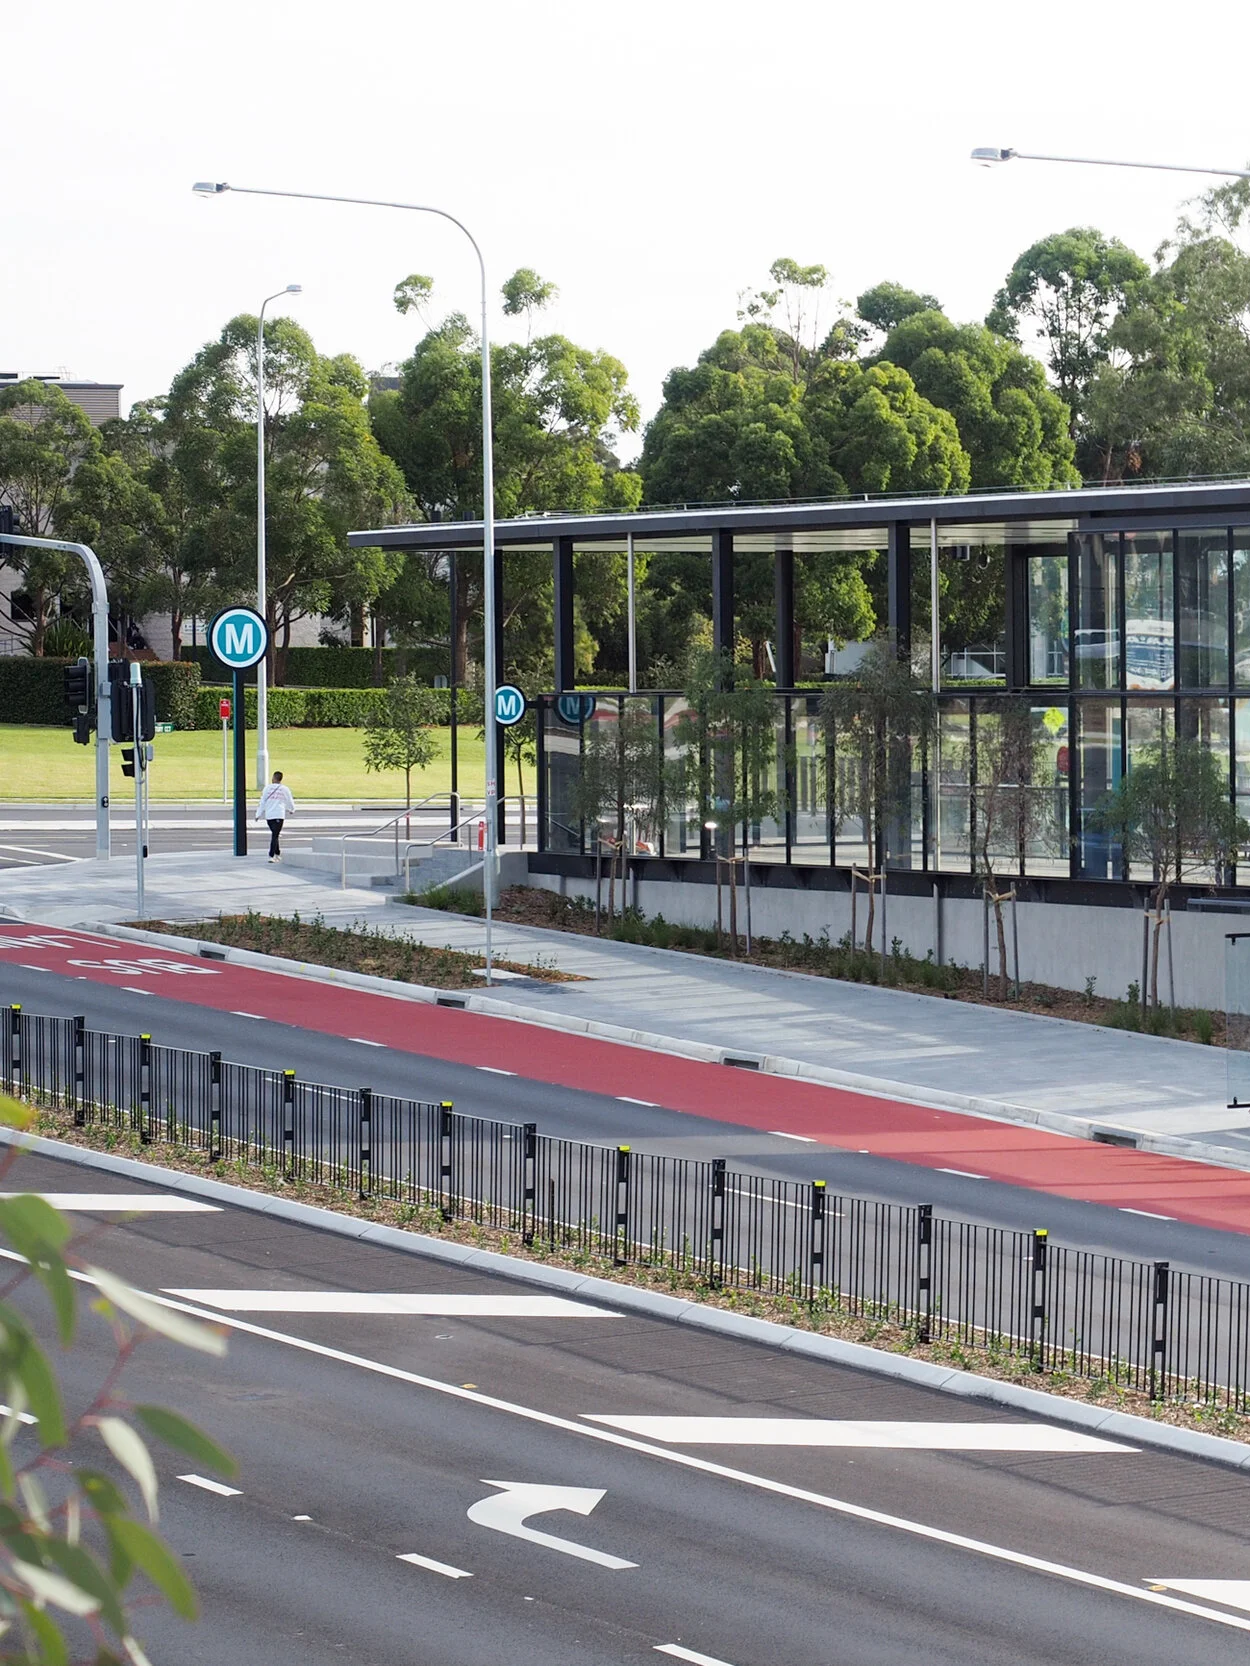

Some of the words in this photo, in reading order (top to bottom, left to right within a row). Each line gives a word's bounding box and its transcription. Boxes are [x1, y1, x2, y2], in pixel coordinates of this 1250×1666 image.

[225, 623, 254, 655] M
[497, 695, 516, 716] M
[66, 958, 223, 975] BUS
